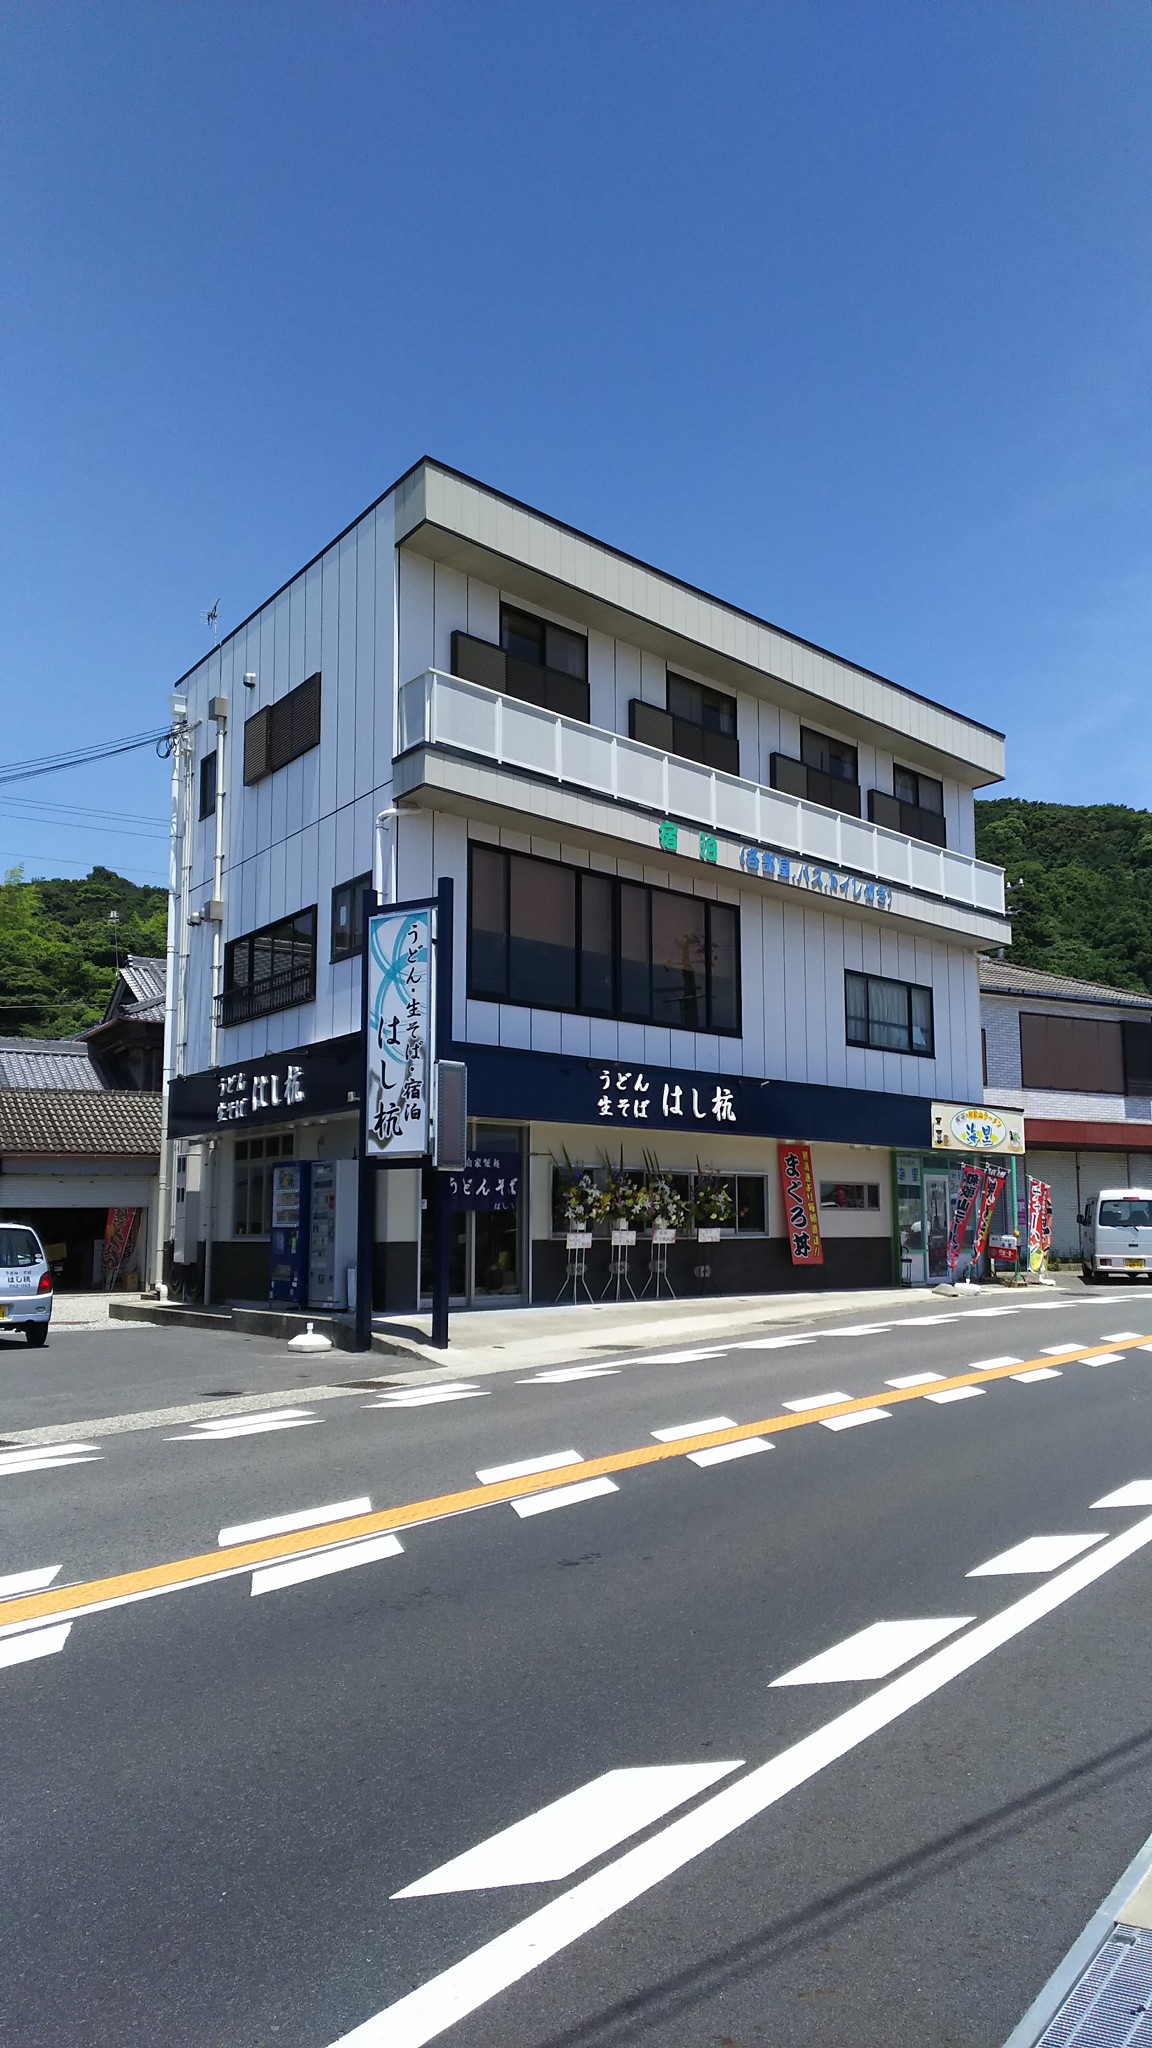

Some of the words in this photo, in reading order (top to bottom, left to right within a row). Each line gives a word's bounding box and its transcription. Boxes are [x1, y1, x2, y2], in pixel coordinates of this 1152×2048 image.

[658, 820, 718, 864] 宿泊
[403, 924, 422, 1122] うどん・生そば・宿泊
[218, 1072, 247, 1097] うどん
[251, 1065, 305, 1112] はし杭
[374, 1015, 404, 1140] はし杭
[598, 1070, 650, 1092] うどん
[216, 1097, 249, 1122] 生そば
[597, 1095, 650, 1119] 生そば
[662, 1083, 737, 1122] はし杭
[494, 1202, 515, 1210] はし
[784, 1152, 811, 1258] まぐろ丼
